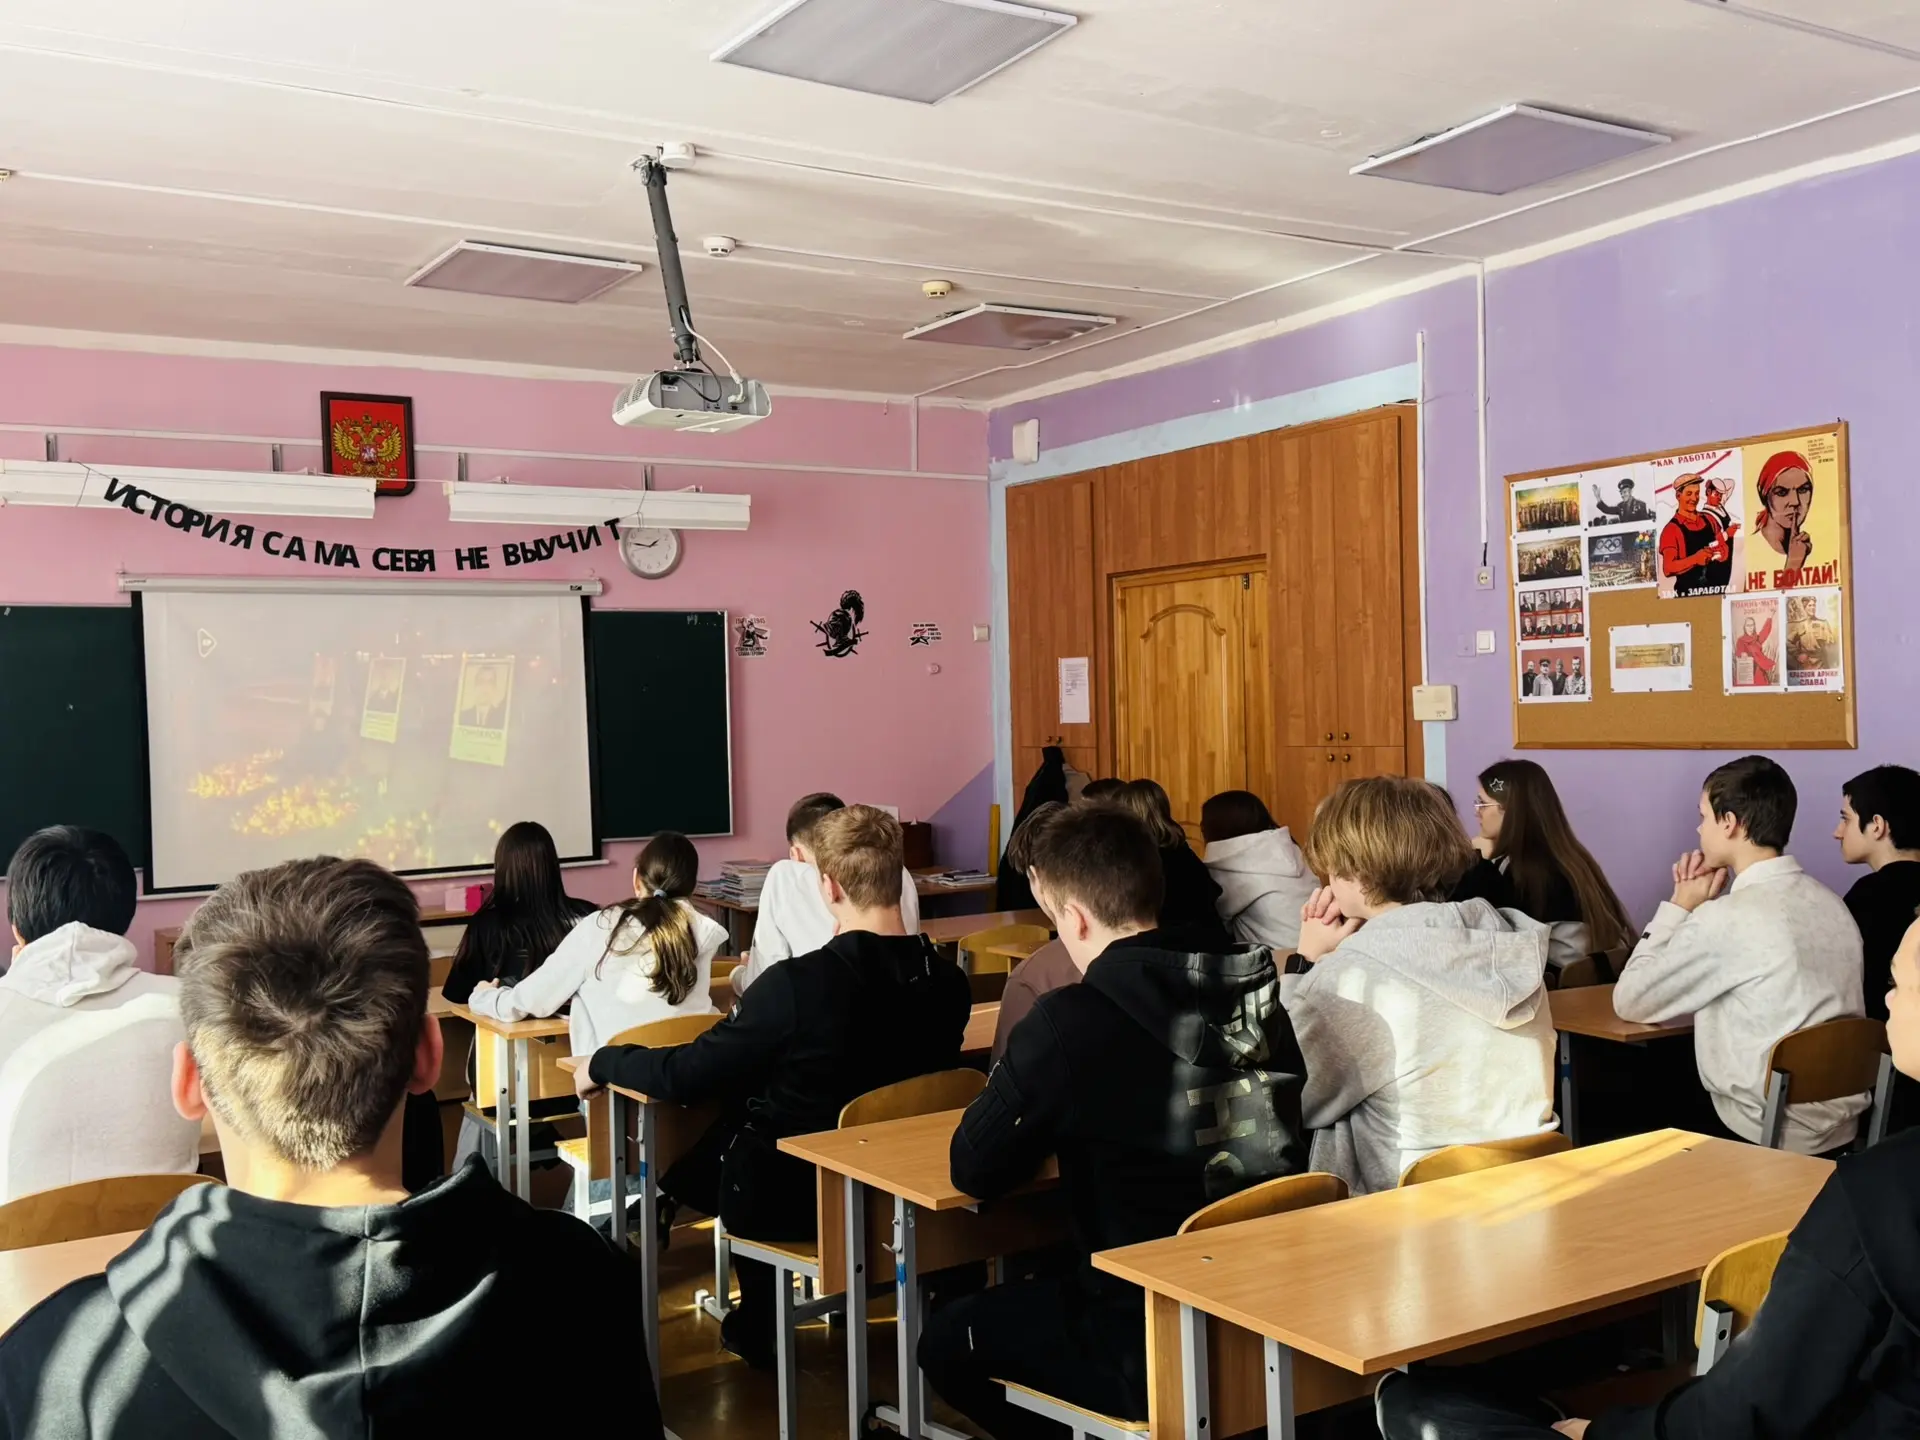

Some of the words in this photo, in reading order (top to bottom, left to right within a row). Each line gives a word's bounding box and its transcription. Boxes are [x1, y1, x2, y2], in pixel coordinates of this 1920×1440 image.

[1656, 458, 1674, 467] КАК
[1678, 451, 1717, 464] РАБОТАЛ
[103, 477, 255, 550] ИСТОРИЯ
[372, 547, 436, 572] СЕБЯ
[454, 546, 490, 571] НЕ
[1748, 570, 1766, 589] НЕ
[1773, 559, 1839, 590] БОЛТАЙ!
